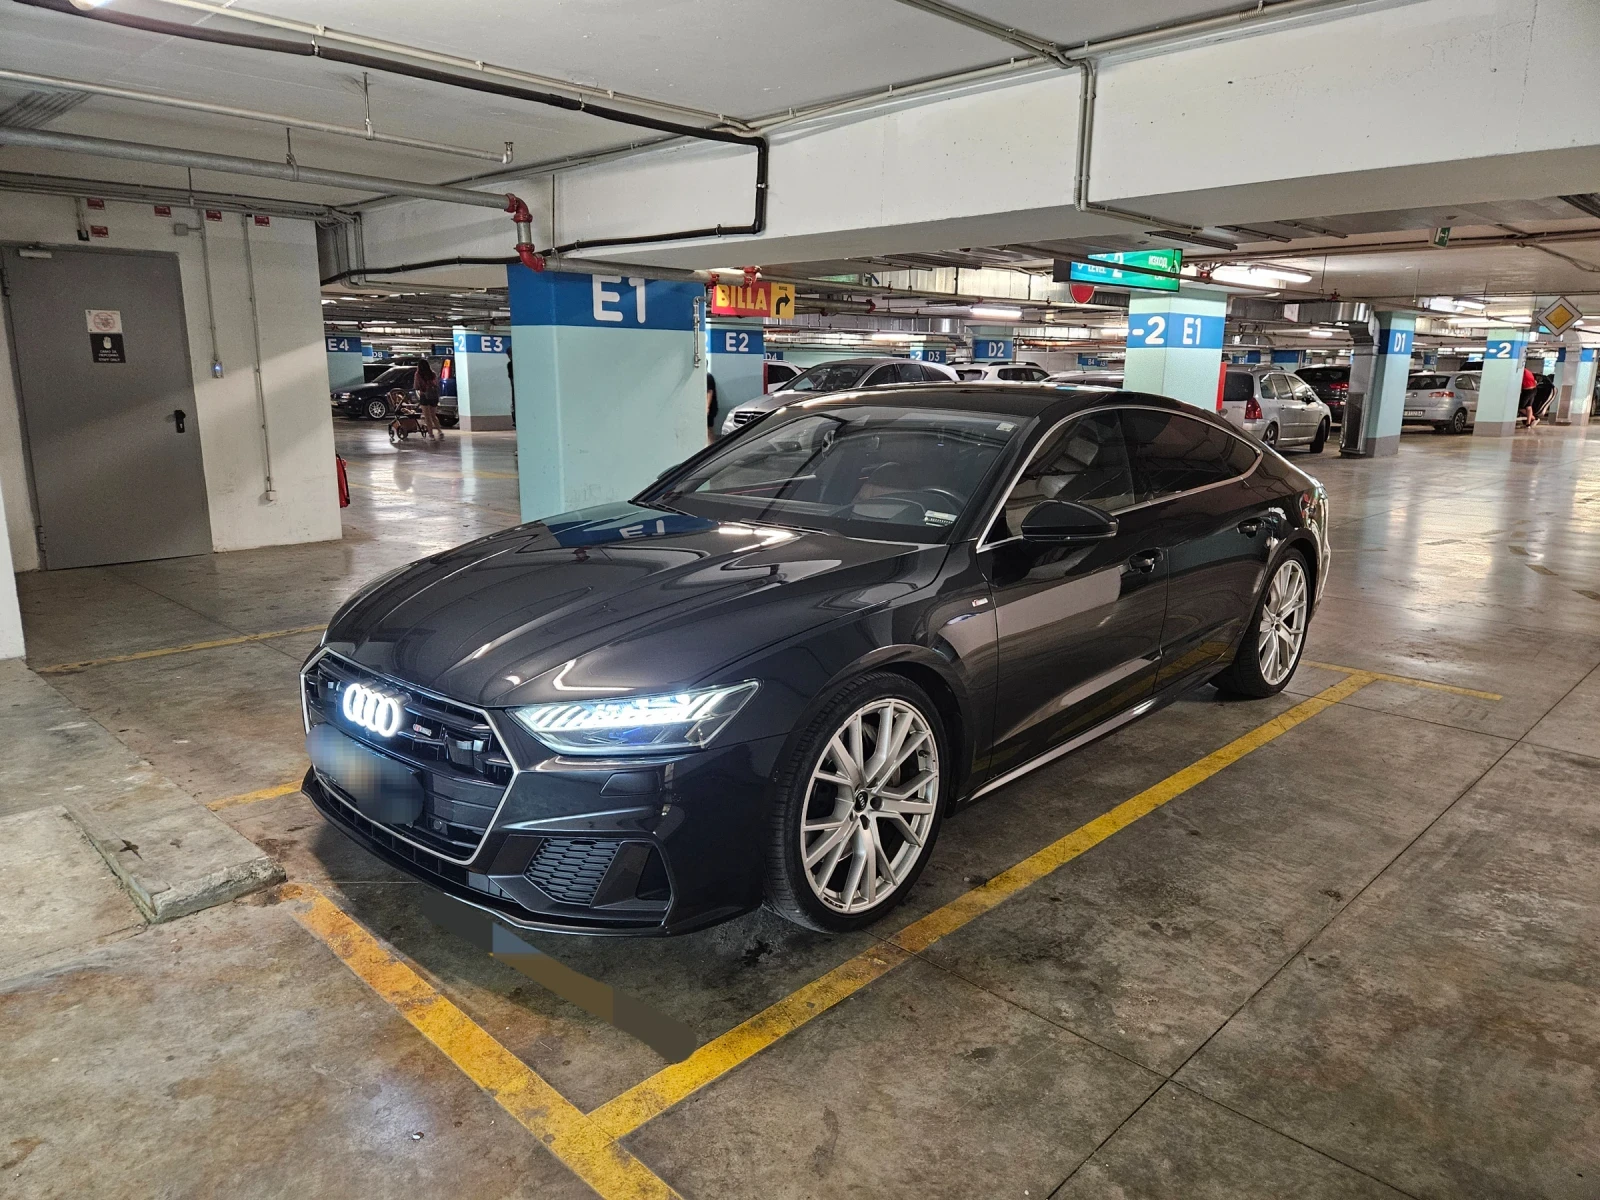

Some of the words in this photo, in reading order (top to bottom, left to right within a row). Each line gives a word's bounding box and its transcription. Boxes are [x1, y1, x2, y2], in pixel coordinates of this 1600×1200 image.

[592, 274, 645, 324] E1
[716, 284, 768, 311] BILLA
[1132, 316, 1166, 345] -2
[1183, 317, 1202, 345] E1
[327, 338, 349, 351] E4
[454, 335, 465, 352] -2
[480, 336, 503, 352] E3
[725, 332, 749, 352] E2
[988, 342, 1004, 357] D2
[1393, 332, 1406, 353] D1
[1488, 342, 1512, 358] -2
[910, 351, 922, 361] -2
[928, 352, 940, 362] D3
